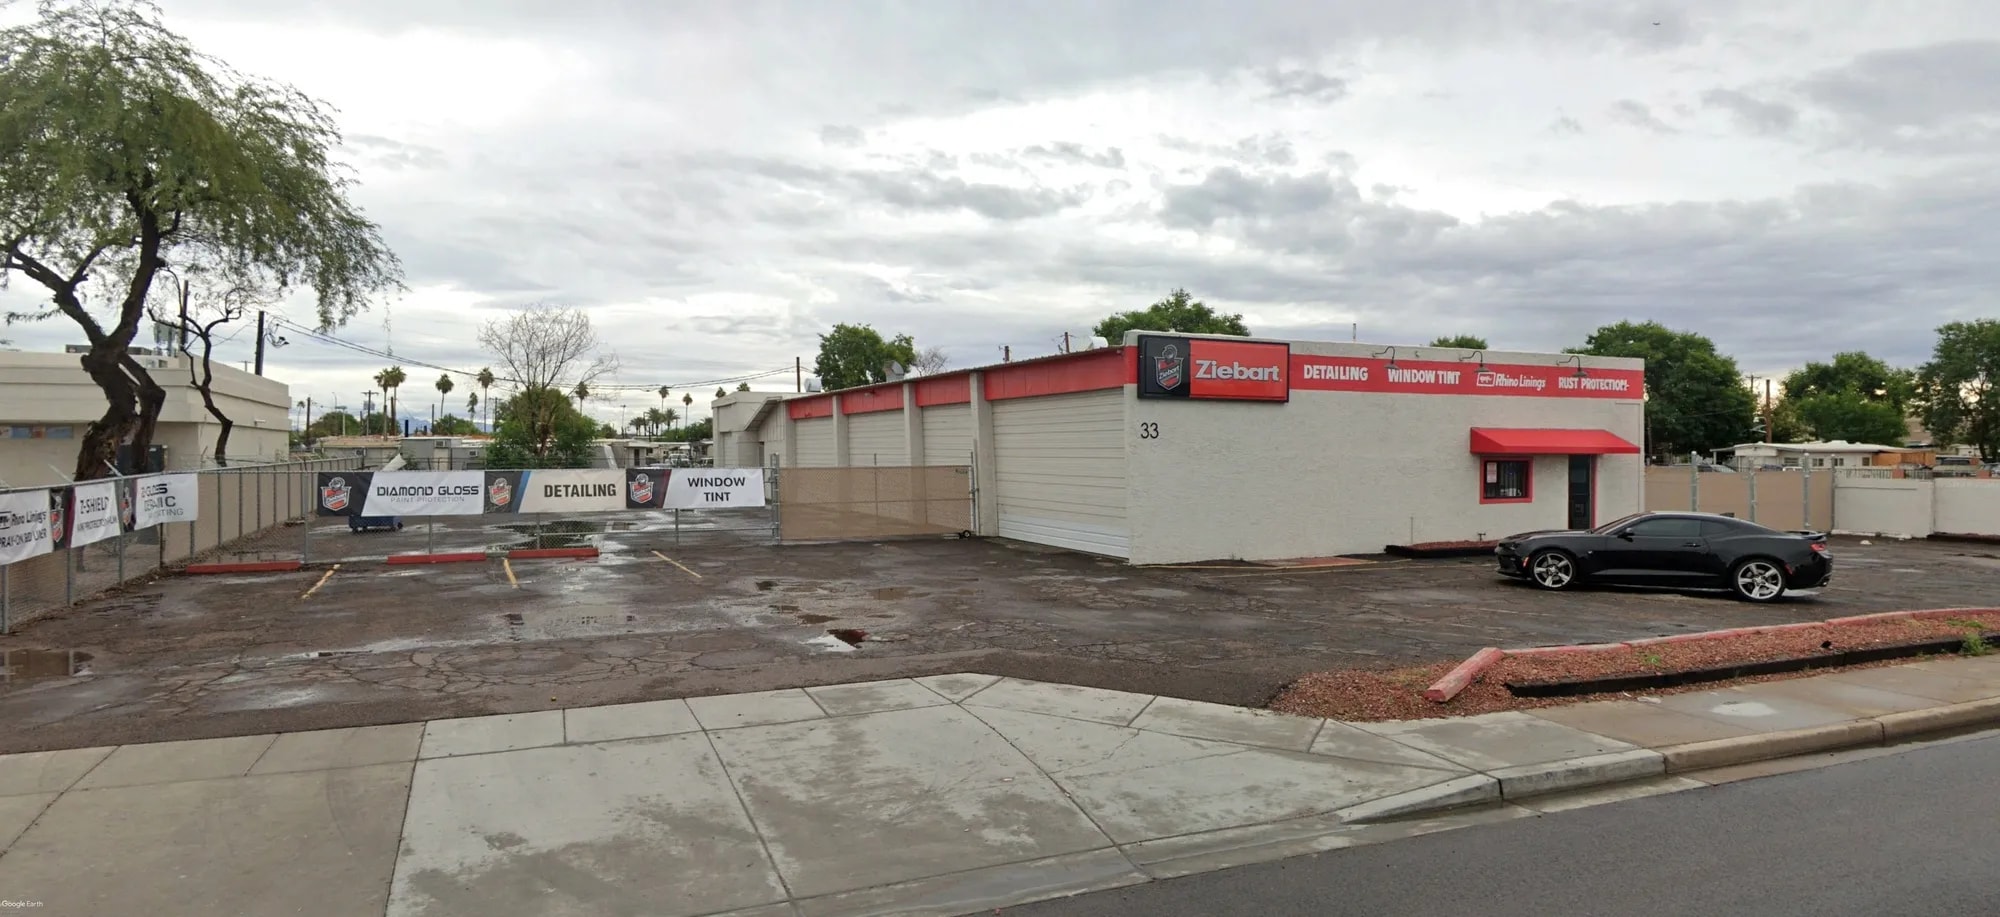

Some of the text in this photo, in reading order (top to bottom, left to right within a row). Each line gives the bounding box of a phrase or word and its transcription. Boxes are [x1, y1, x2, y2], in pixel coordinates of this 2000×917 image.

[1195, 360, 1280, 382] Ziebart
[1304, 364, 1368, 381] DETAILING
[1387, 368, 1461, 385] WINDOW TINT
[1495, 373, 1546, 391] Rhino Linings
[1558, 376, 1579, 389] RUST
[1140, 422, 1159, 439] 33
[687, 476, 746, 488] WINDOW
[376, 485, 479, 497] DIAMOND GLOSS
[543, 483, 617, 498] DETAILING
[703, 491, 731, 502] TINT
